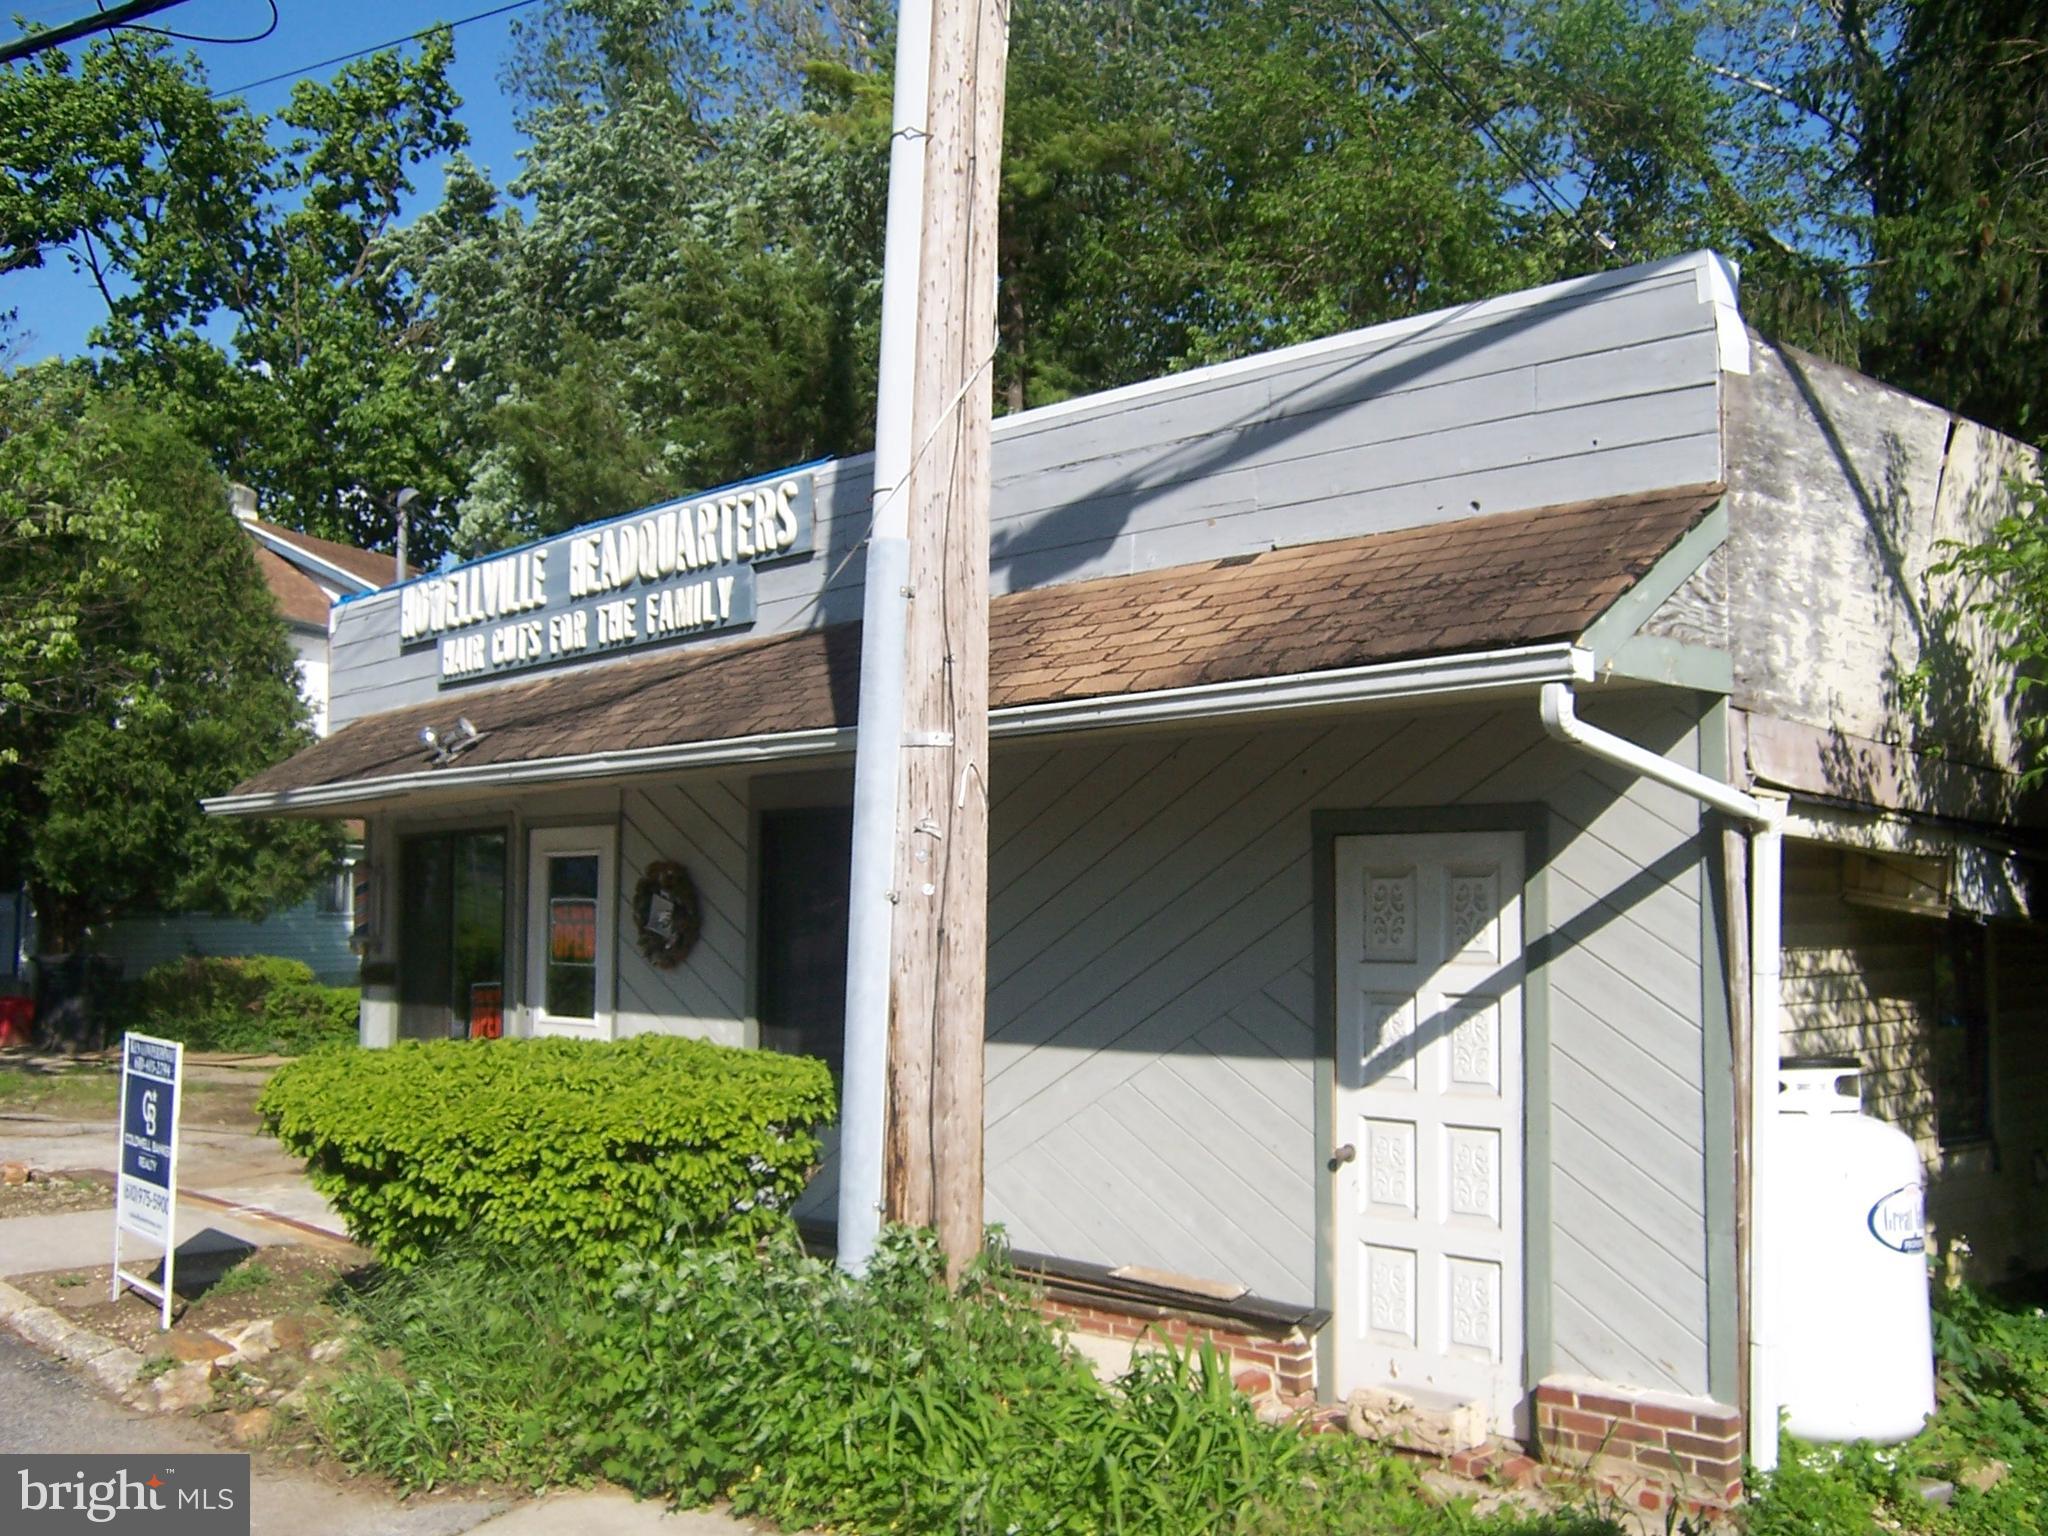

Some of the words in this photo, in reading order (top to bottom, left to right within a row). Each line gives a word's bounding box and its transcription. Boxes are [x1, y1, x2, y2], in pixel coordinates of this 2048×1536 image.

[401, 549, 548, 638] HOWELLVILLE
[569, 481, 799, 597] HEADQUARTERS
[442, 634, 486, 676] HAIR
[491, 620, 543, 665] CUTS
[550, 610, 588, 654] FOR
[596, 598, 637, 645] THE
[646, 576, 735, 635] FAMILY
